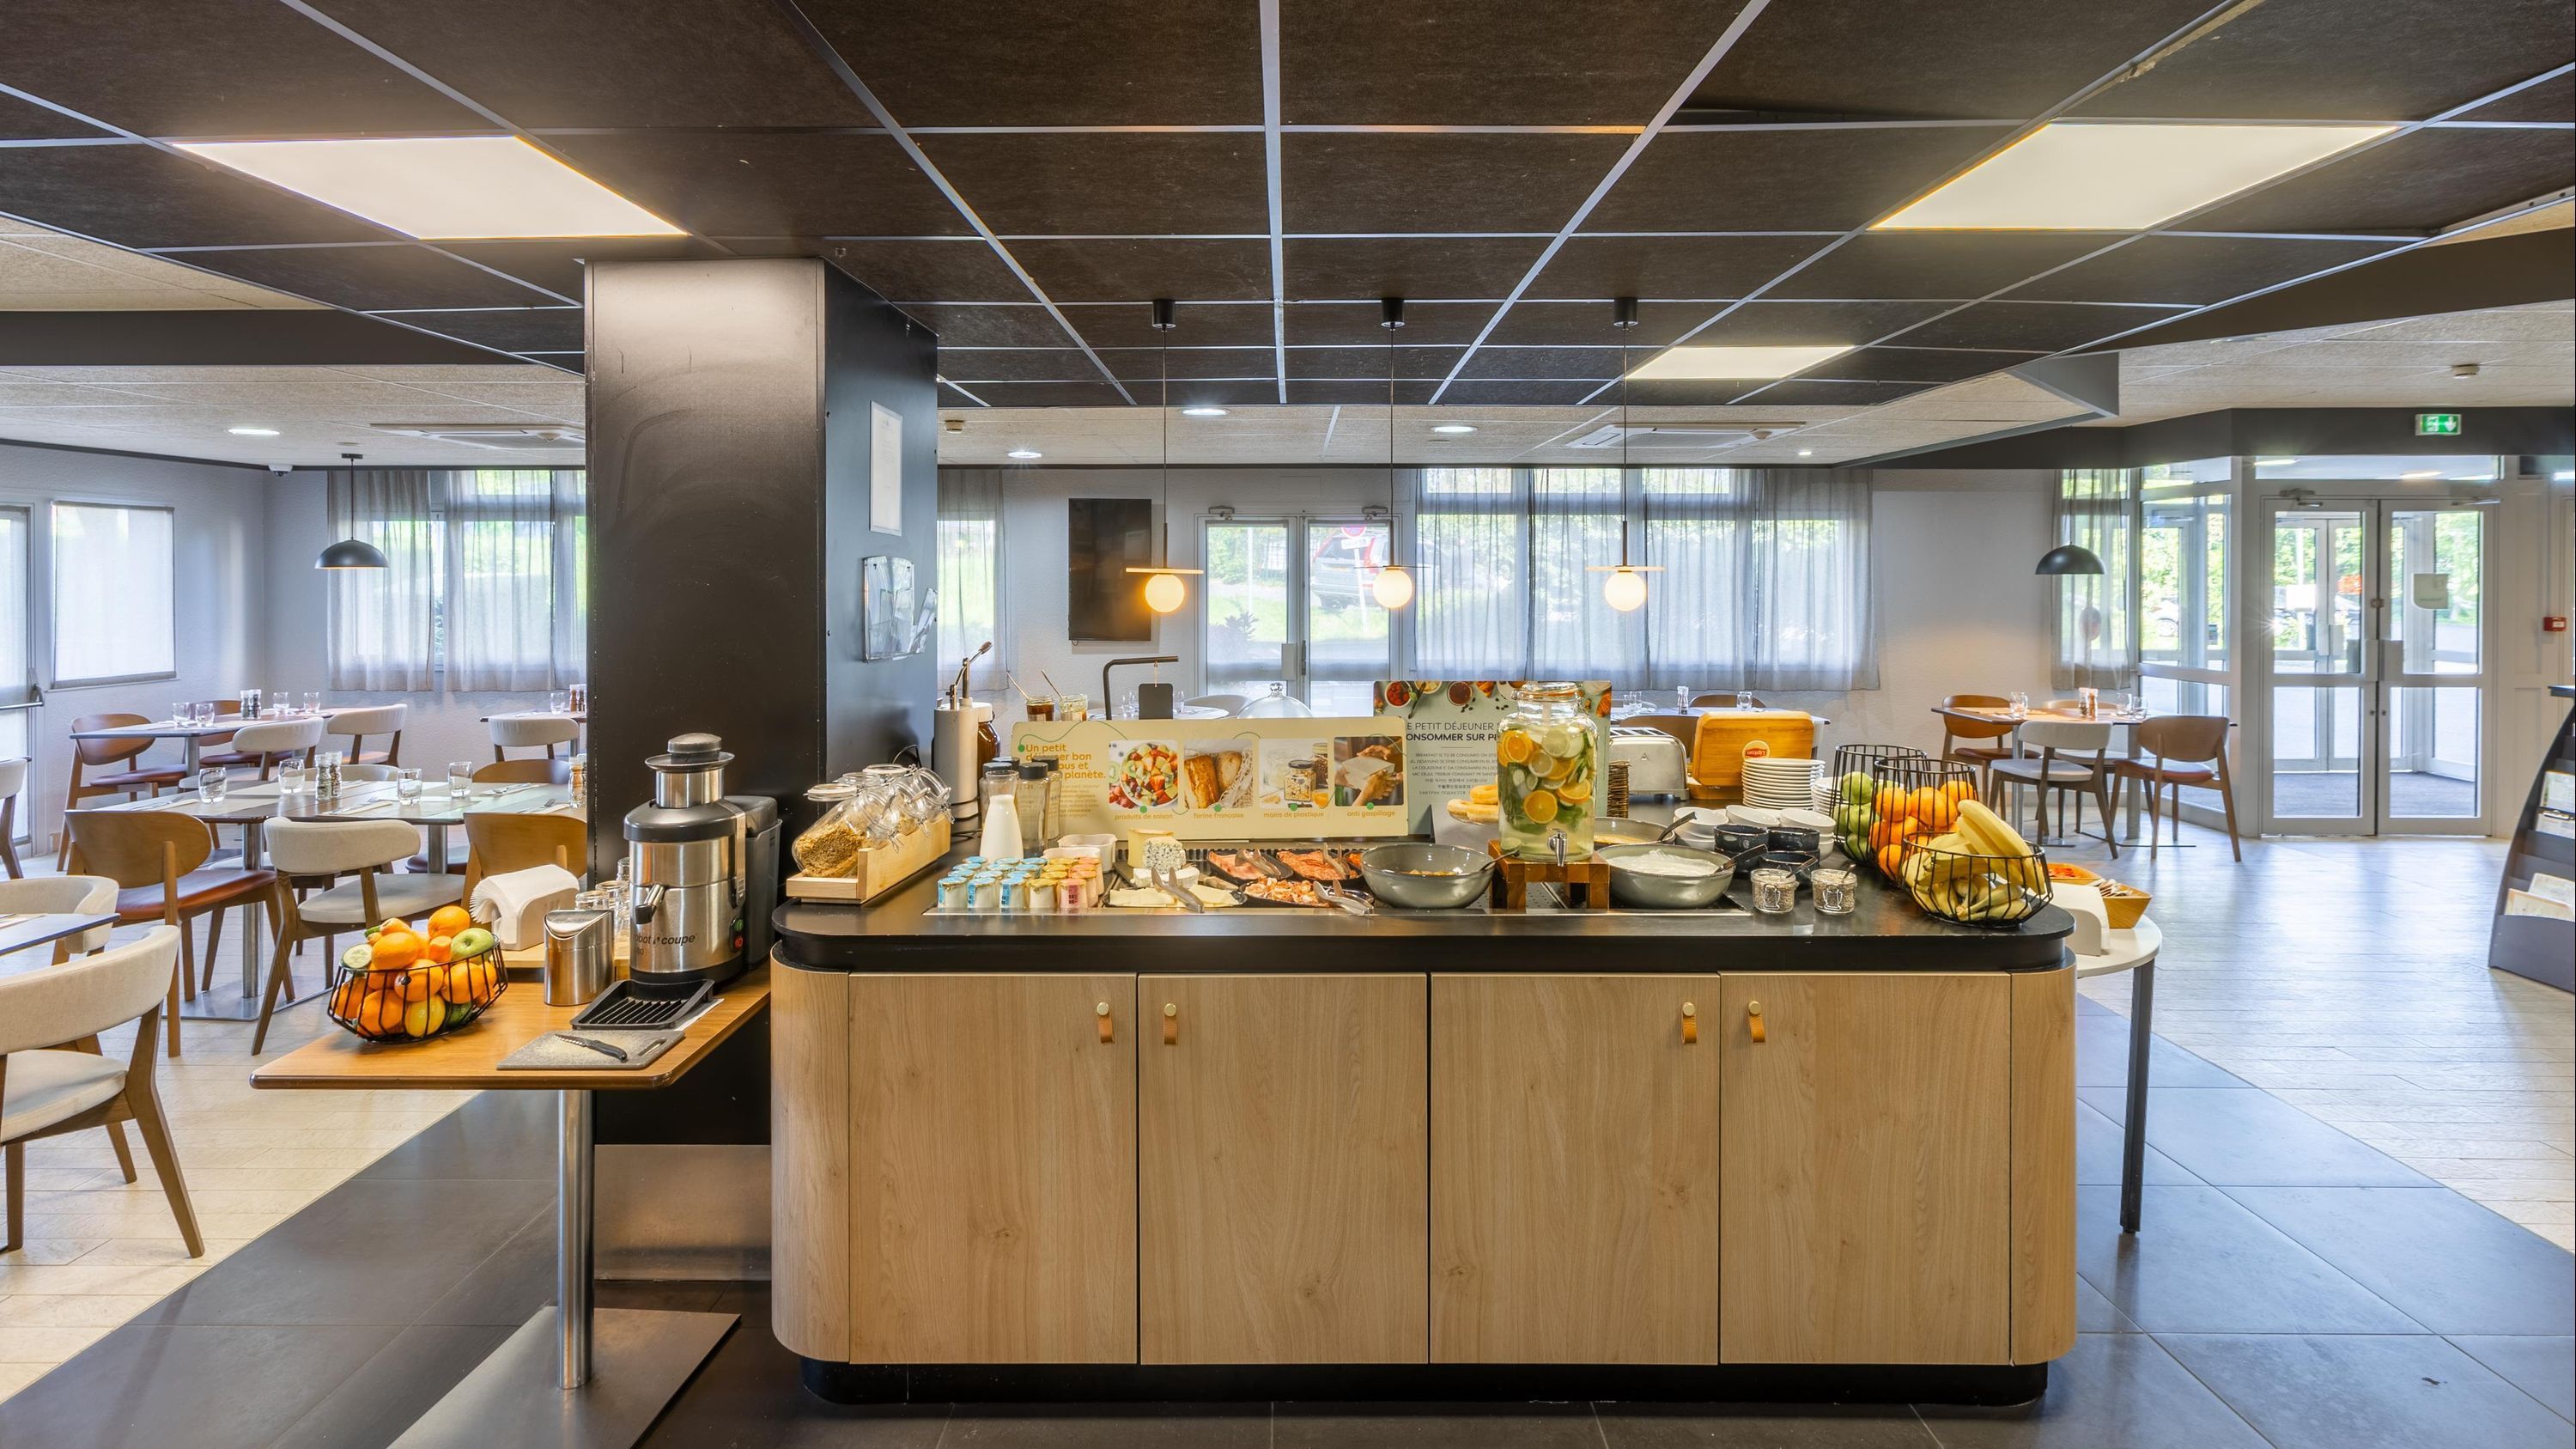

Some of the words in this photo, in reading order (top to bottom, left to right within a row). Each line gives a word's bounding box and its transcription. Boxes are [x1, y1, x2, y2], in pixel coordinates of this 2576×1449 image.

[1444, 721, 1494, 730] DÉJEUNER
[1026, 744, 1039, 752] Un
[1042, 744, 1066, 753] petit
[1072, 752, 1092, 761] bon
[1065, 770, 1106, 780] planète.
[661, 935, 696, 946] coupe
